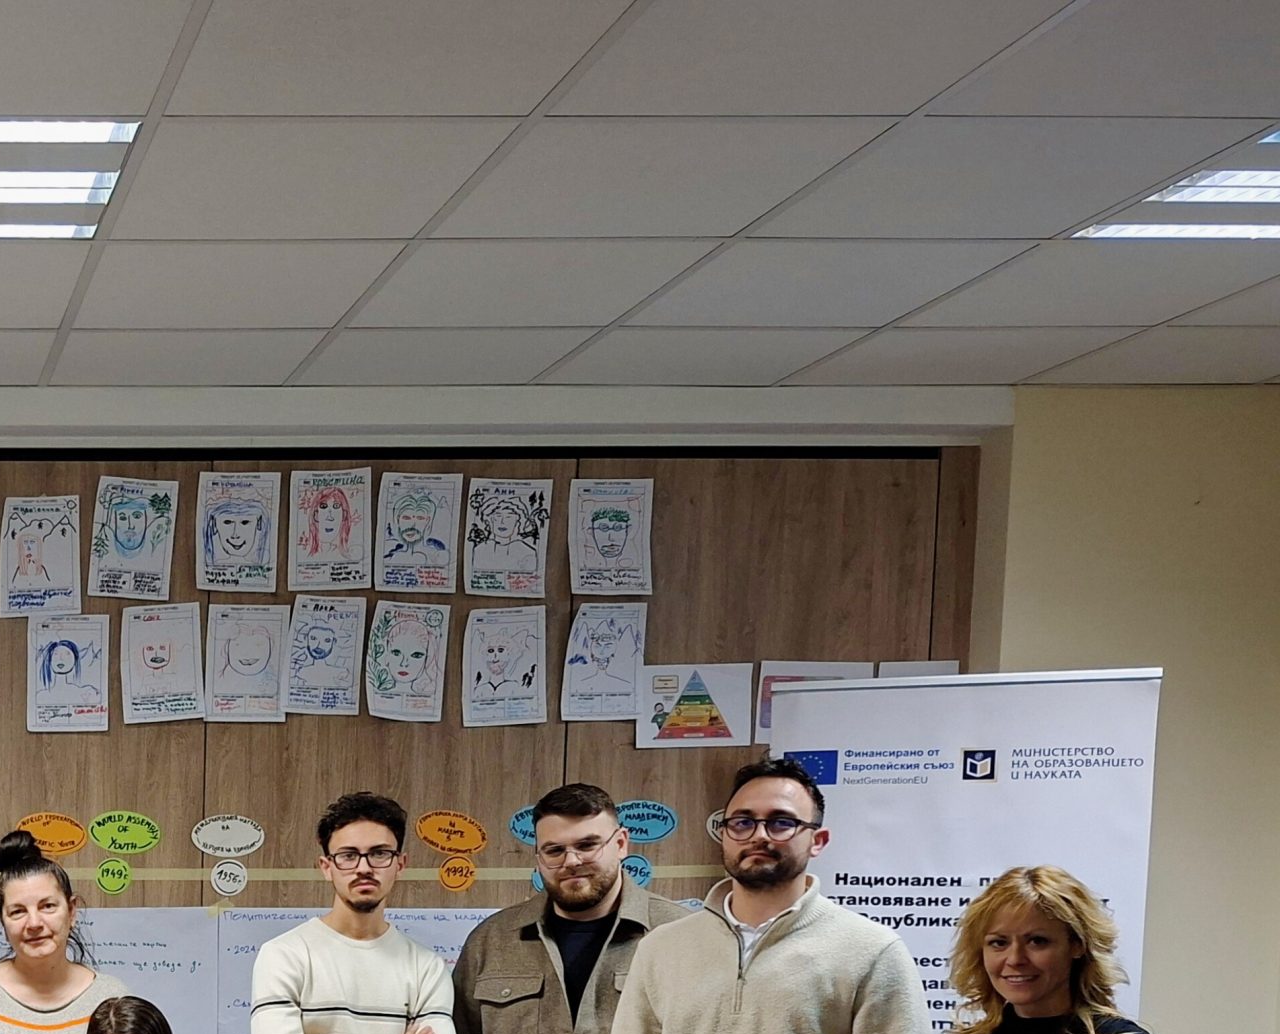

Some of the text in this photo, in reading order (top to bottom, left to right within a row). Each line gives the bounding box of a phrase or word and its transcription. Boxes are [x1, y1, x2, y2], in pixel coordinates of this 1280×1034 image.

[844, 749, 940, 759] Финансирано от
[1011, 746, 1115, 758] МИНИСТЕРСТВО
[843, 761, 955, 773] Европейския съюз
[1011, 757, 1145, 769] НА ОБРАЗОВАНИЕТО
[842, 776, 928, 785] NextGenerationEU
[1011, 769, 1083, 780] И НАУКАТА
[95, 813, 124, 828] WORLD
[117, 824, 130, 833] OF
[107, 836, 138, 851] YOUTH
[835, 873, 962, 888] Национален
